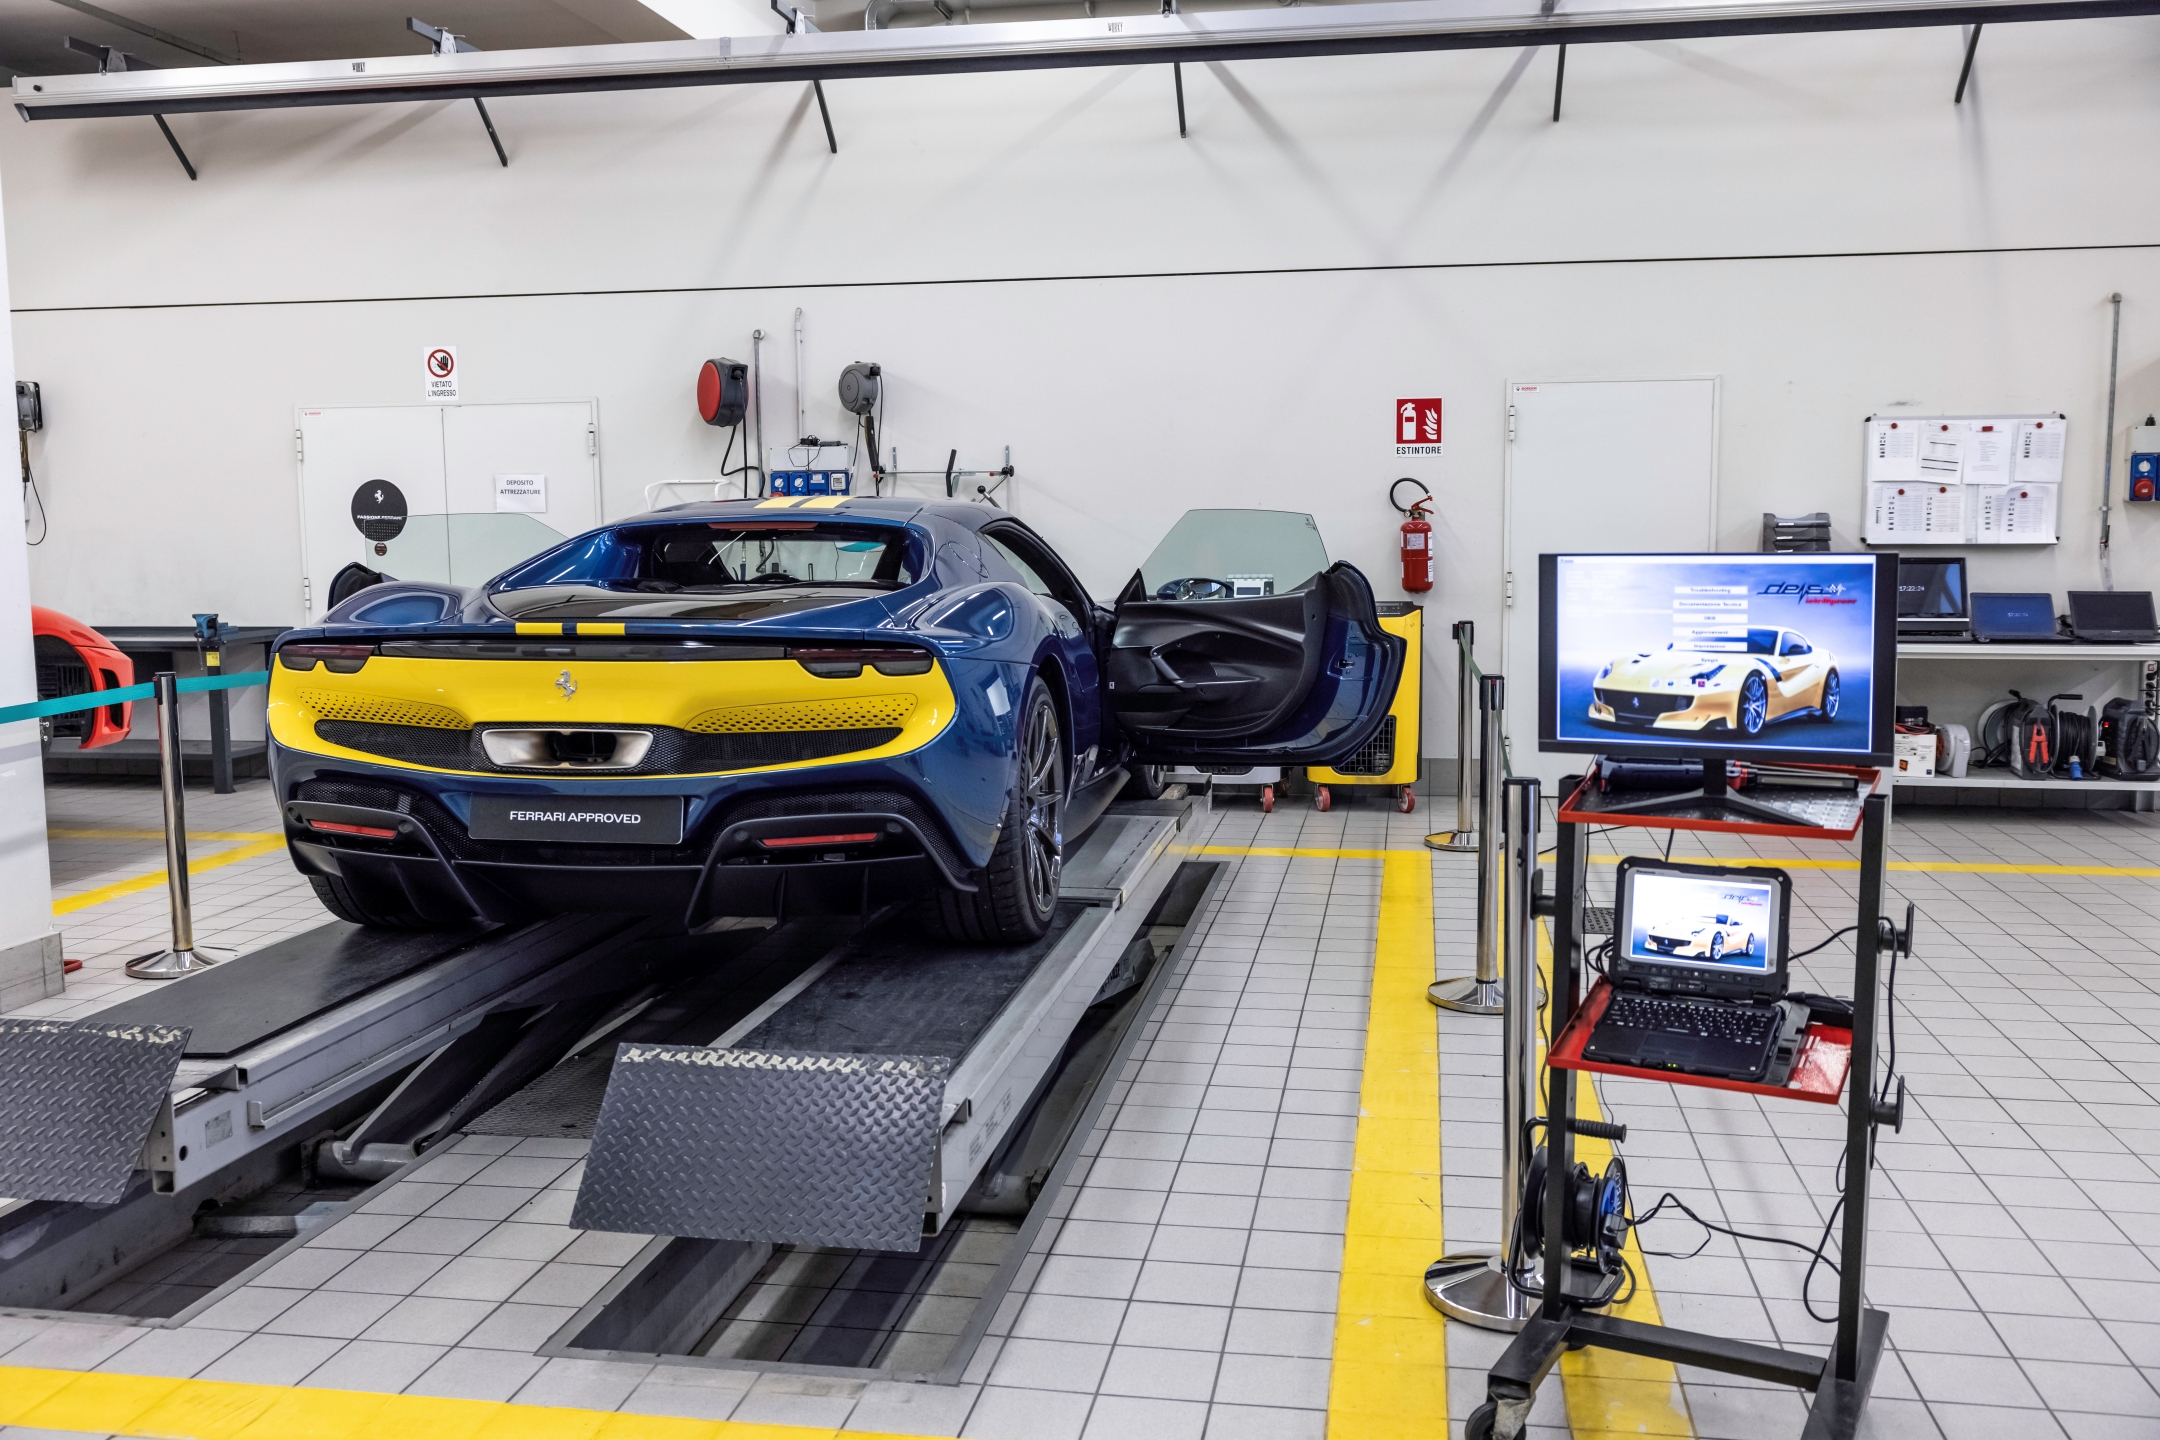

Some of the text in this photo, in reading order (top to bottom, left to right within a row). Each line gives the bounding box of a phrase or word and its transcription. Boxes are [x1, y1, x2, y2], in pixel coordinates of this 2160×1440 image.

[1396, 446, 1441, 454] ESTINTORE
[509, 810, 641, 824] FERRARI APPROVED
